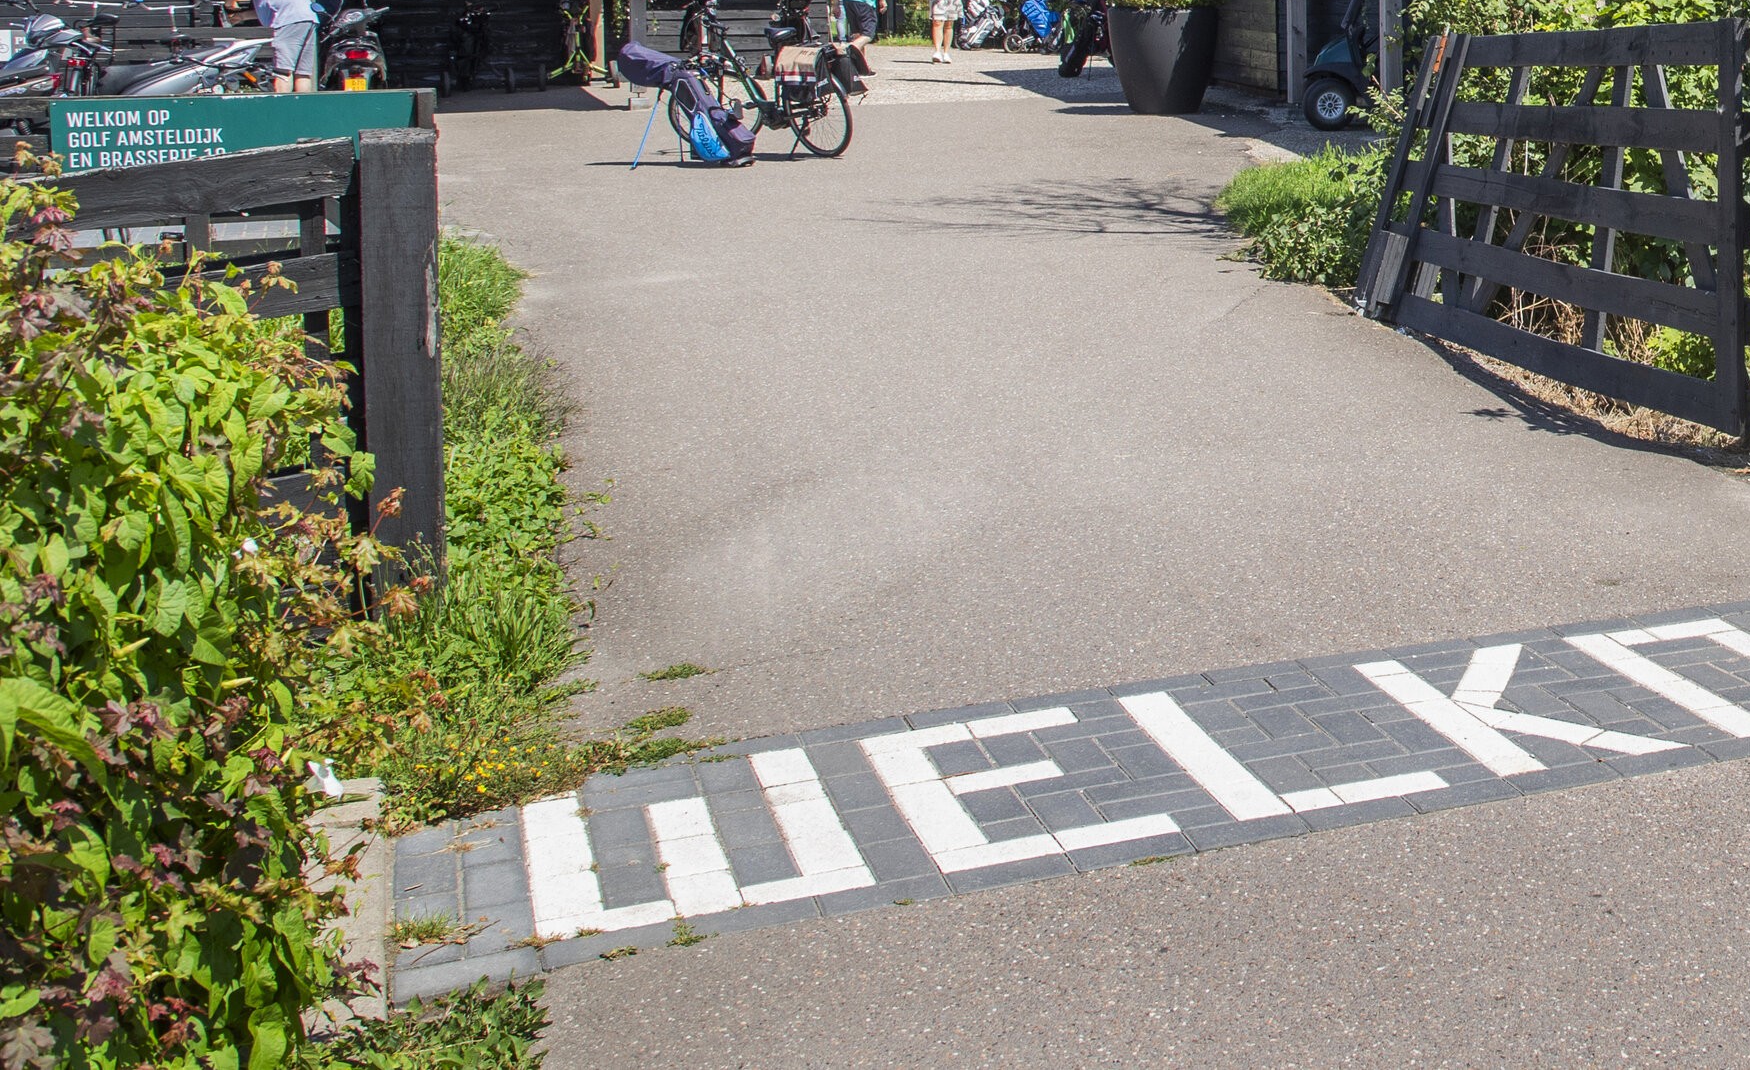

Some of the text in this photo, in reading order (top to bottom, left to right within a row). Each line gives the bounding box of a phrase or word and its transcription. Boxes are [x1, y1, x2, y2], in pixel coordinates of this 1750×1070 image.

[66, 109, 170, 128] WELKOM OP
[67, 127, 223, 148] GOLF AMSTELDIJK
[69, 152, 93, 168] EN
[99, 148, 198, 167] BRASSERIE
